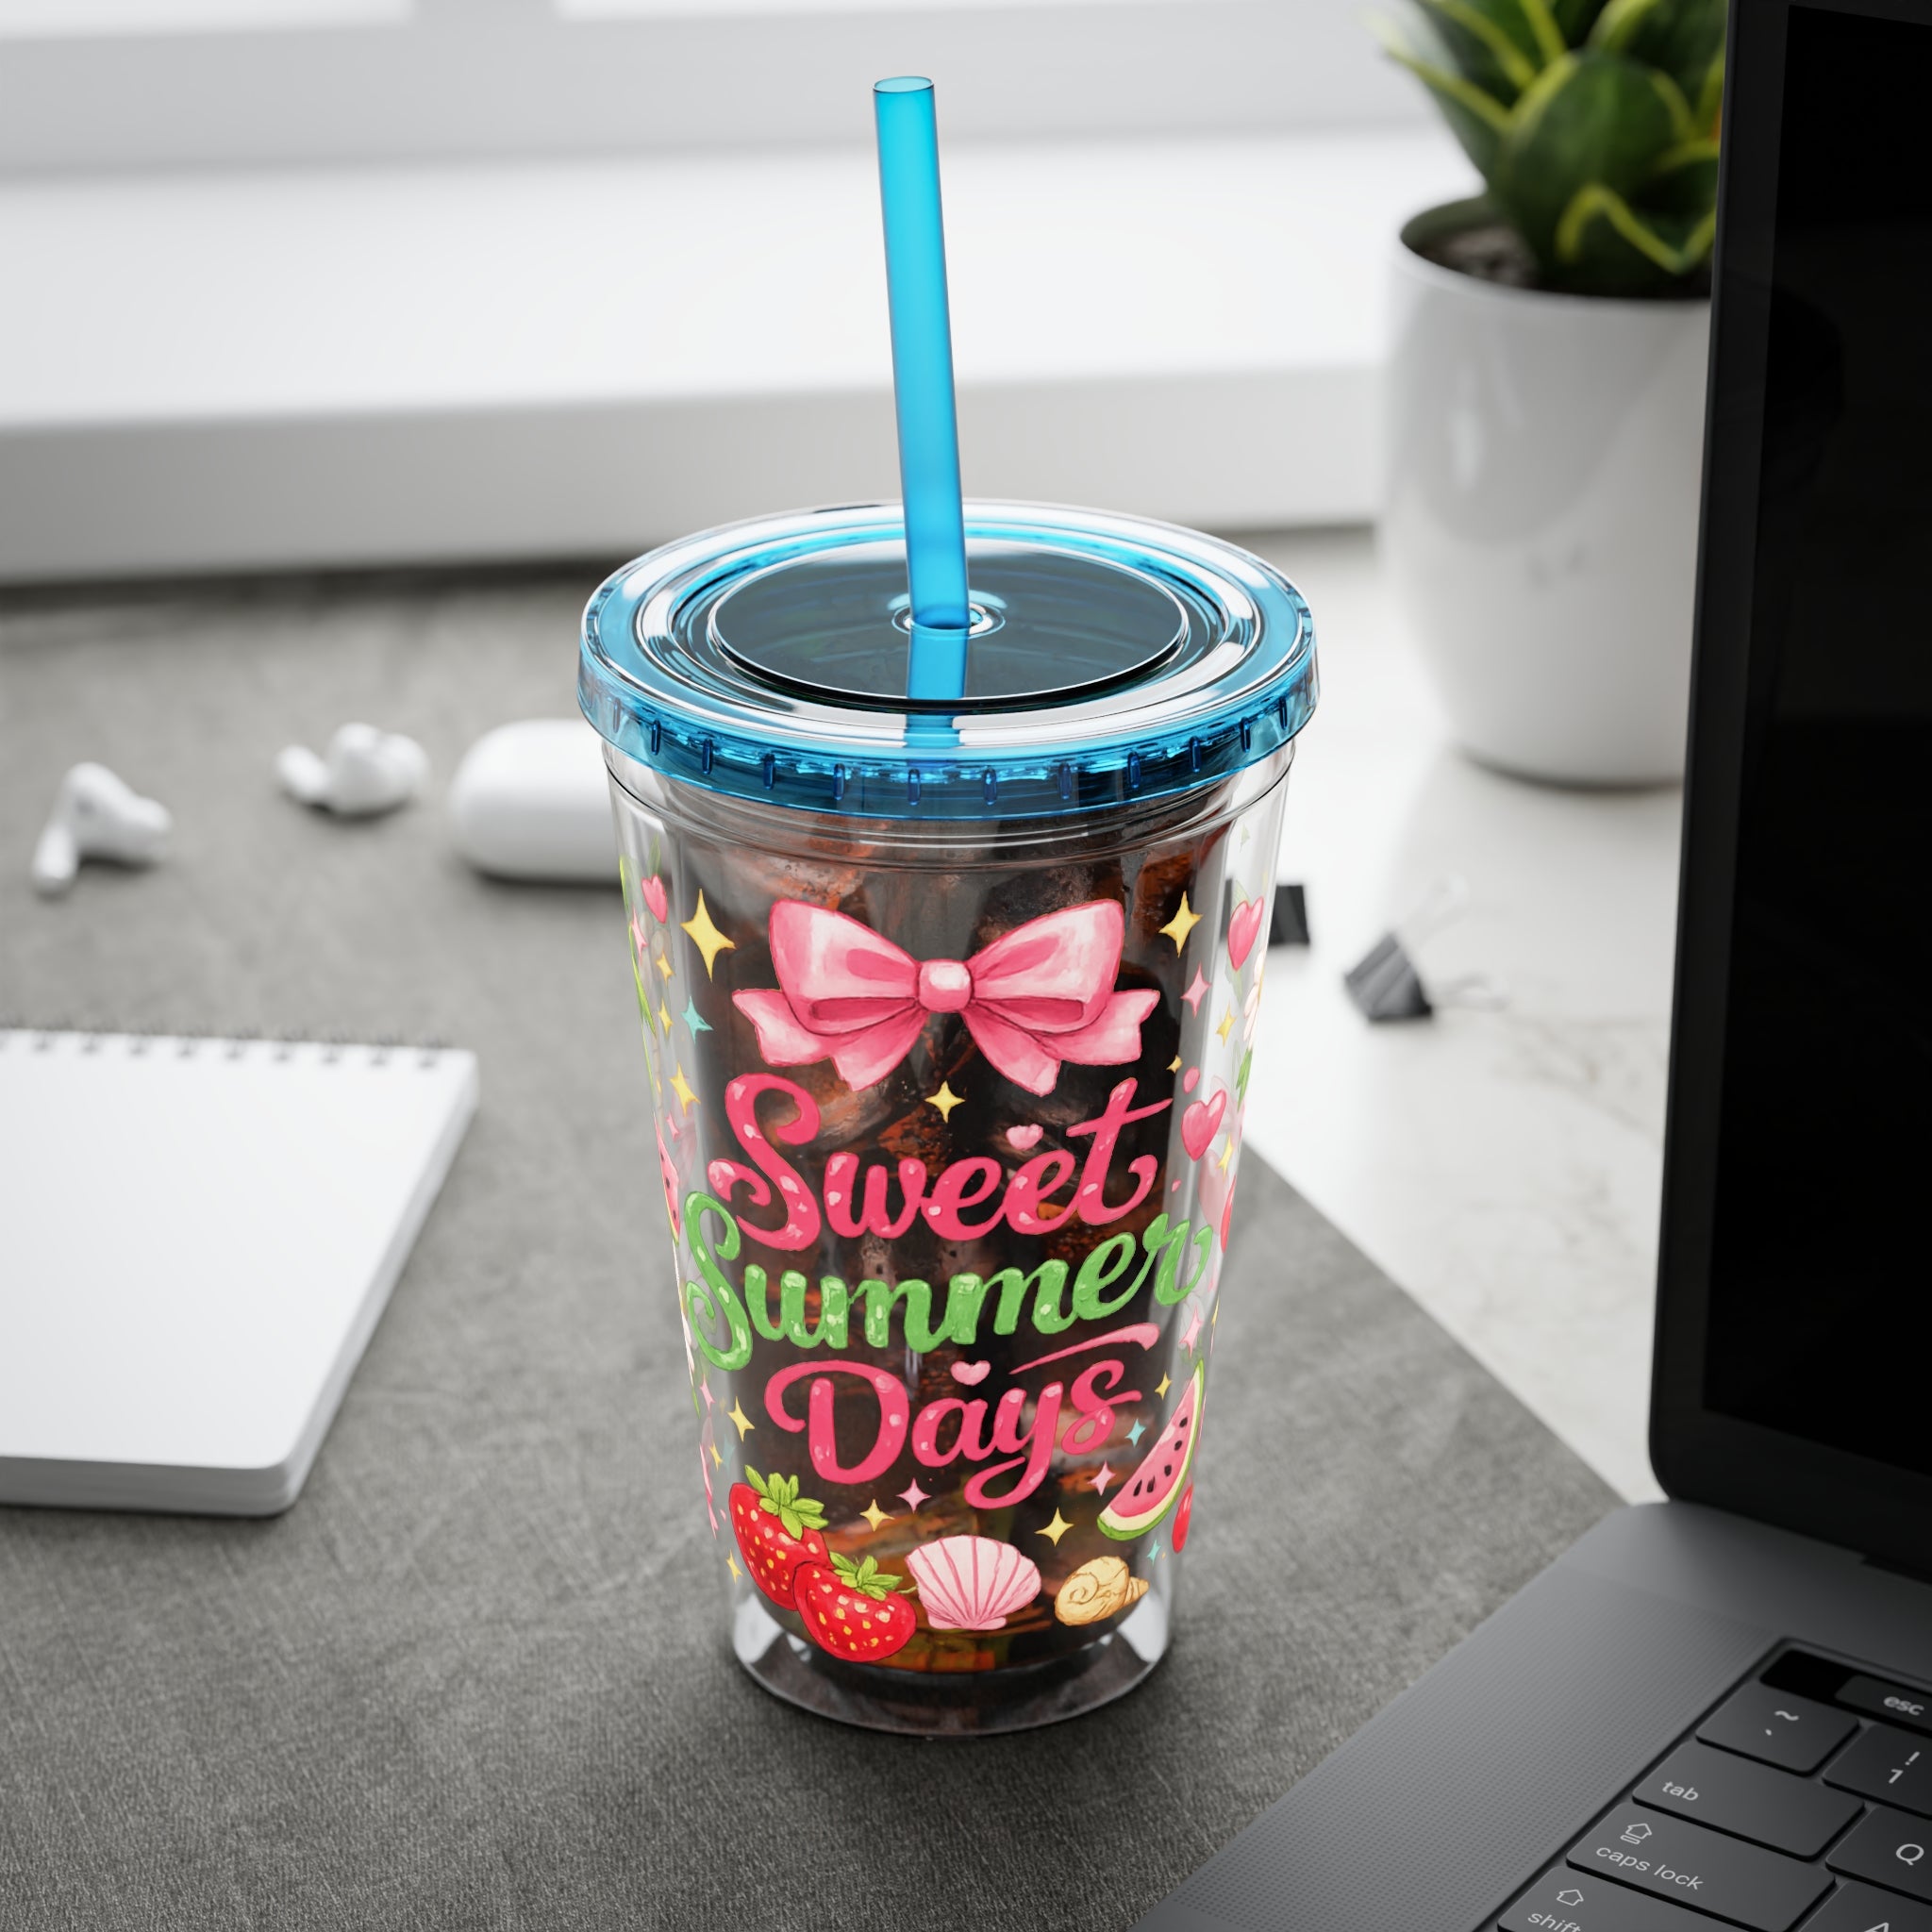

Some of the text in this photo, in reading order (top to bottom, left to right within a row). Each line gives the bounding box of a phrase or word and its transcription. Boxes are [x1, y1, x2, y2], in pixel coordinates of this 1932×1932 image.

[708, 1073, 1173, 1251] Sweet
[683, 1191, 1213, 1371] Summer
[764, 1359, 1141, 1509] Days
[1883, 1696, 1924, 1716] esc
[1905, 1751, 1921, 1766] !
[1889, 1769, 1904, 1784] 1
[1661, 1780, 1699, 1801] tab
[1895, 1843, 1924, 1866] Q
[1596, 1846, 1704, 1890] caps lock
